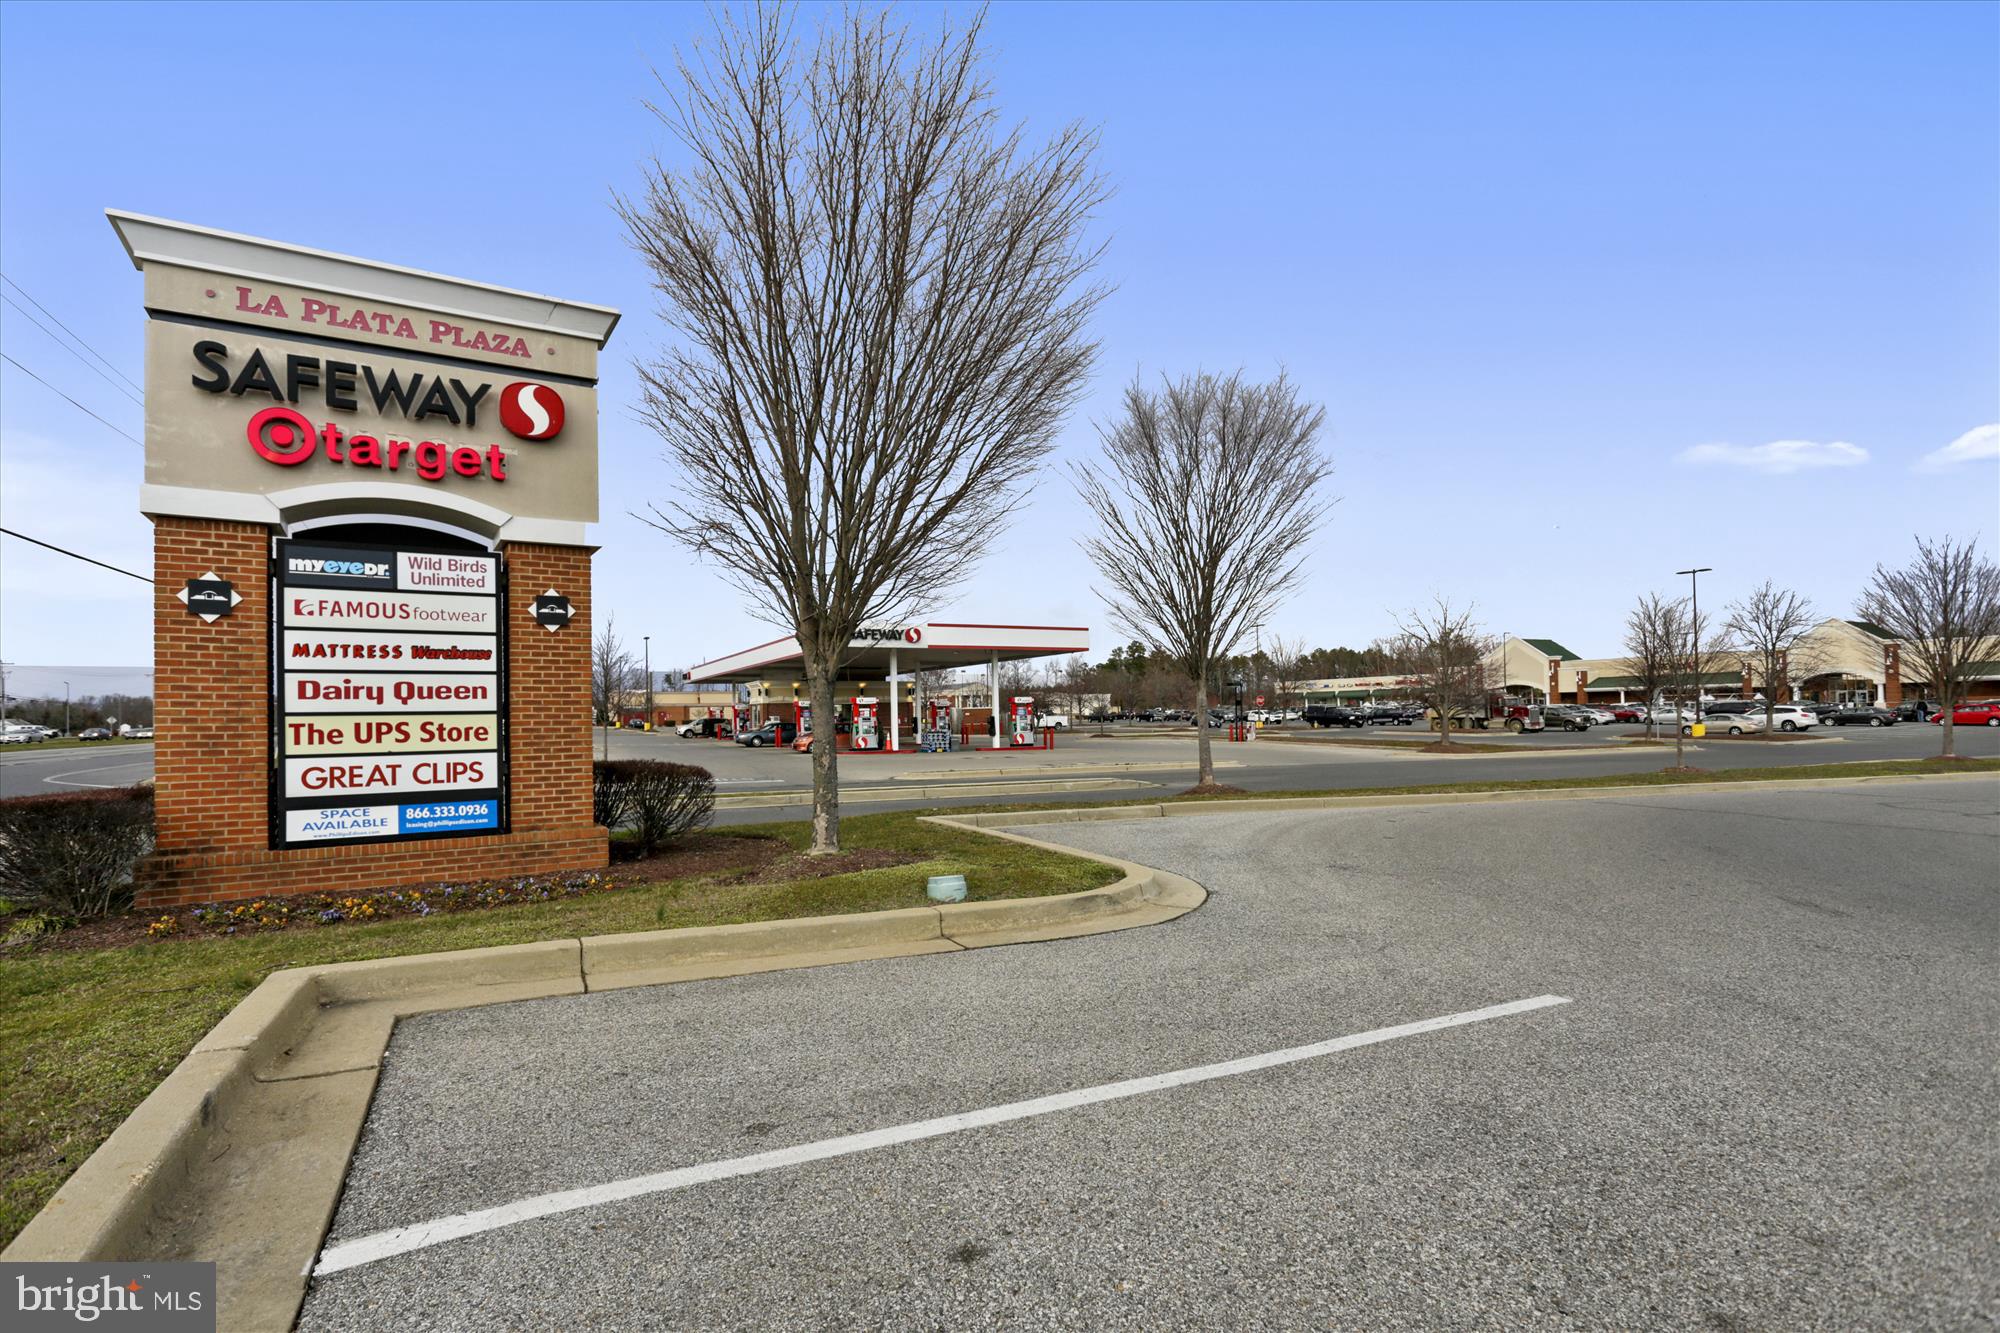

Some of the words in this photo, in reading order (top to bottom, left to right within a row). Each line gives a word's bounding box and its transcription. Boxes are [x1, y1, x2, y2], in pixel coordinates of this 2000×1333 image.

[236, 286, 288, 318] LA
[301, 297, 418, 339] PLATA
[429, 320, 532, 358] PLAZA
[191, 341, 493, 426] SAFEWAY
[321, 422, 506, 481] target
[408, 556, 442, 571] Wild
[447, 559, 487, 573] Birds
[410, 572, 485, 588] Unlimited
[318, 600, 411, 620] FAMOUS
[413, 607, 487, 622] footwear
[292, 643, 402, 659] MATTRESS
[411, 645, 492, 660] Warehouse
[297, 678, 384, 705] Dairy
[393, 681, 488, 705] Queen
[288, 723, 344, 745] The
[354, 721, 411, 744] UPS
[420, 721, 489, 743] Store
[301, 764, 402, 790] GREAT
[412, 761, 484, 785] CLIPS
[320, 807, 371, 819] SPACE
[406, 804, 488, 819] 866.333.0936
[302, 817, 388, 831] AVAILABLE
